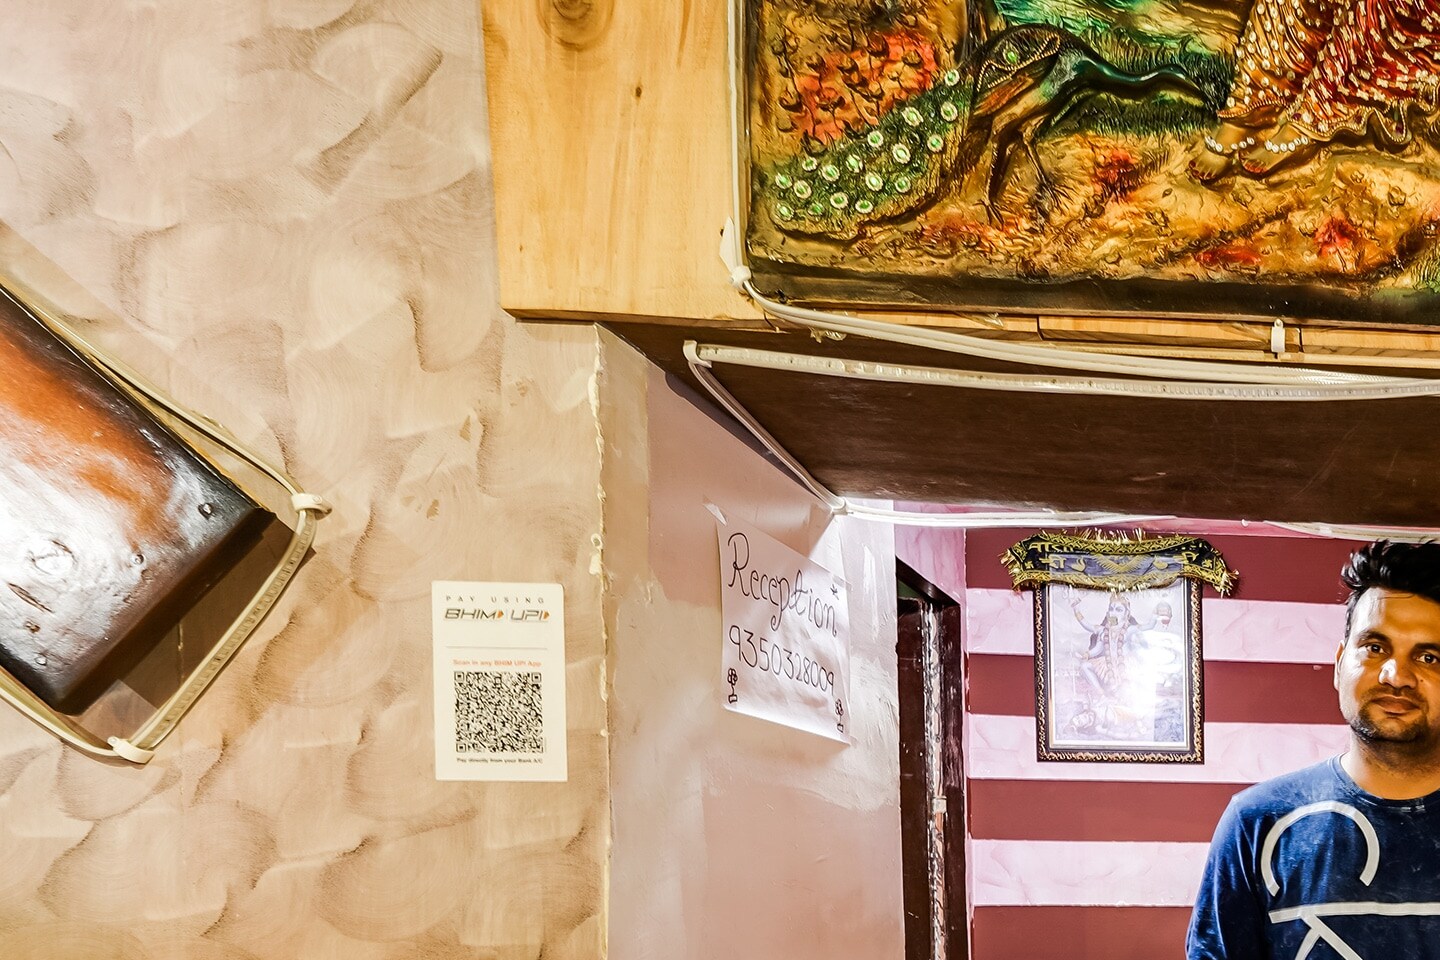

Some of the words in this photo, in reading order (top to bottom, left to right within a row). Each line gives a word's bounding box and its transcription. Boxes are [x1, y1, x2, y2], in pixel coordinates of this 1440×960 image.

[444, 608, 497, 620] BHIM
[511, 609, 543, 621] UPI
[727, 532, 837, 637] Reception
[728, 625, 835, 697] 9350328009
